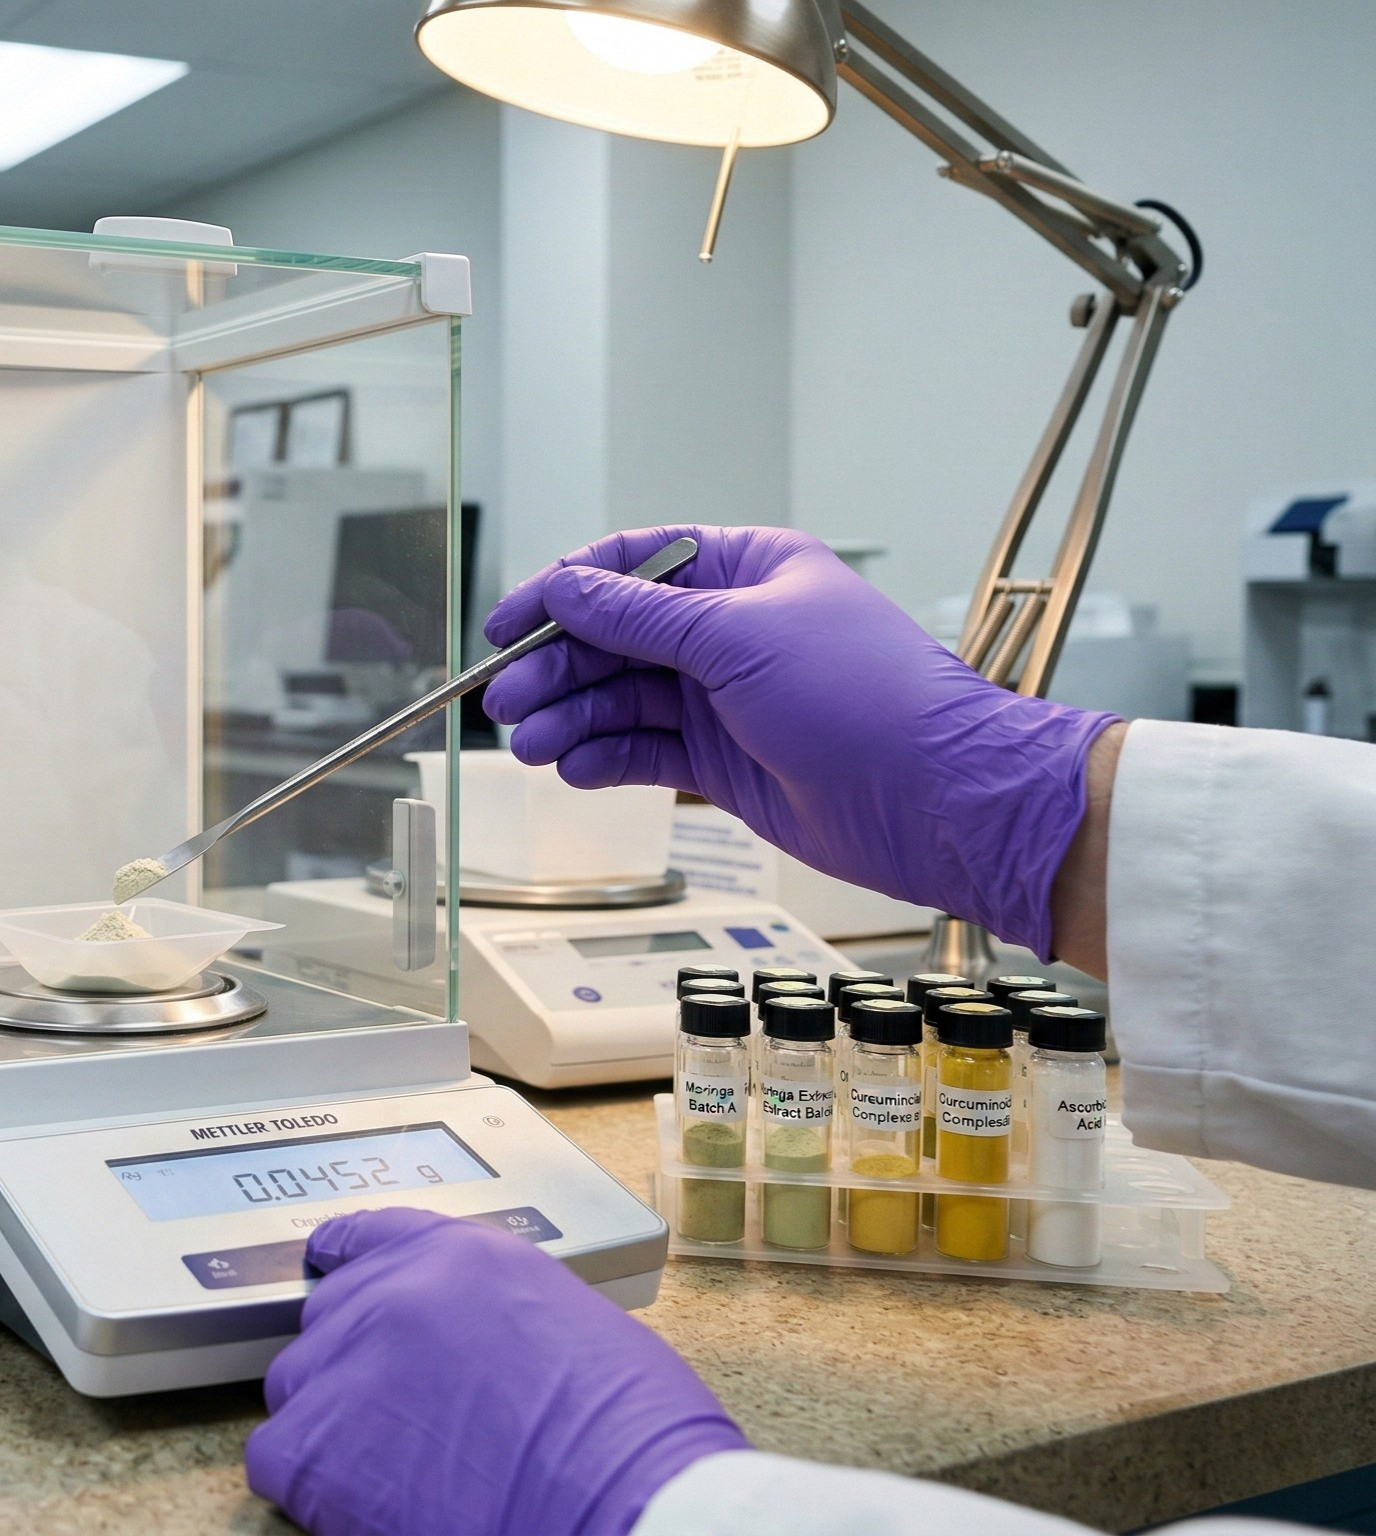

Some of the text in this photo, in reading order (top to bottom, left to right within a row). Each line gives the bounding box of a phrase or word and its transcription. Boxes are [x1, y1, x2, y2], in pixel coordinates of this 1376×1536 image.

[685, 1081, 735, 1100] Moringa
[688, 1098, 737, 1114] Batch A
[189, 1113, 339, 1141] METTLER TOLEDO
[231, 1156, 444, 1203] 0.0452 g
